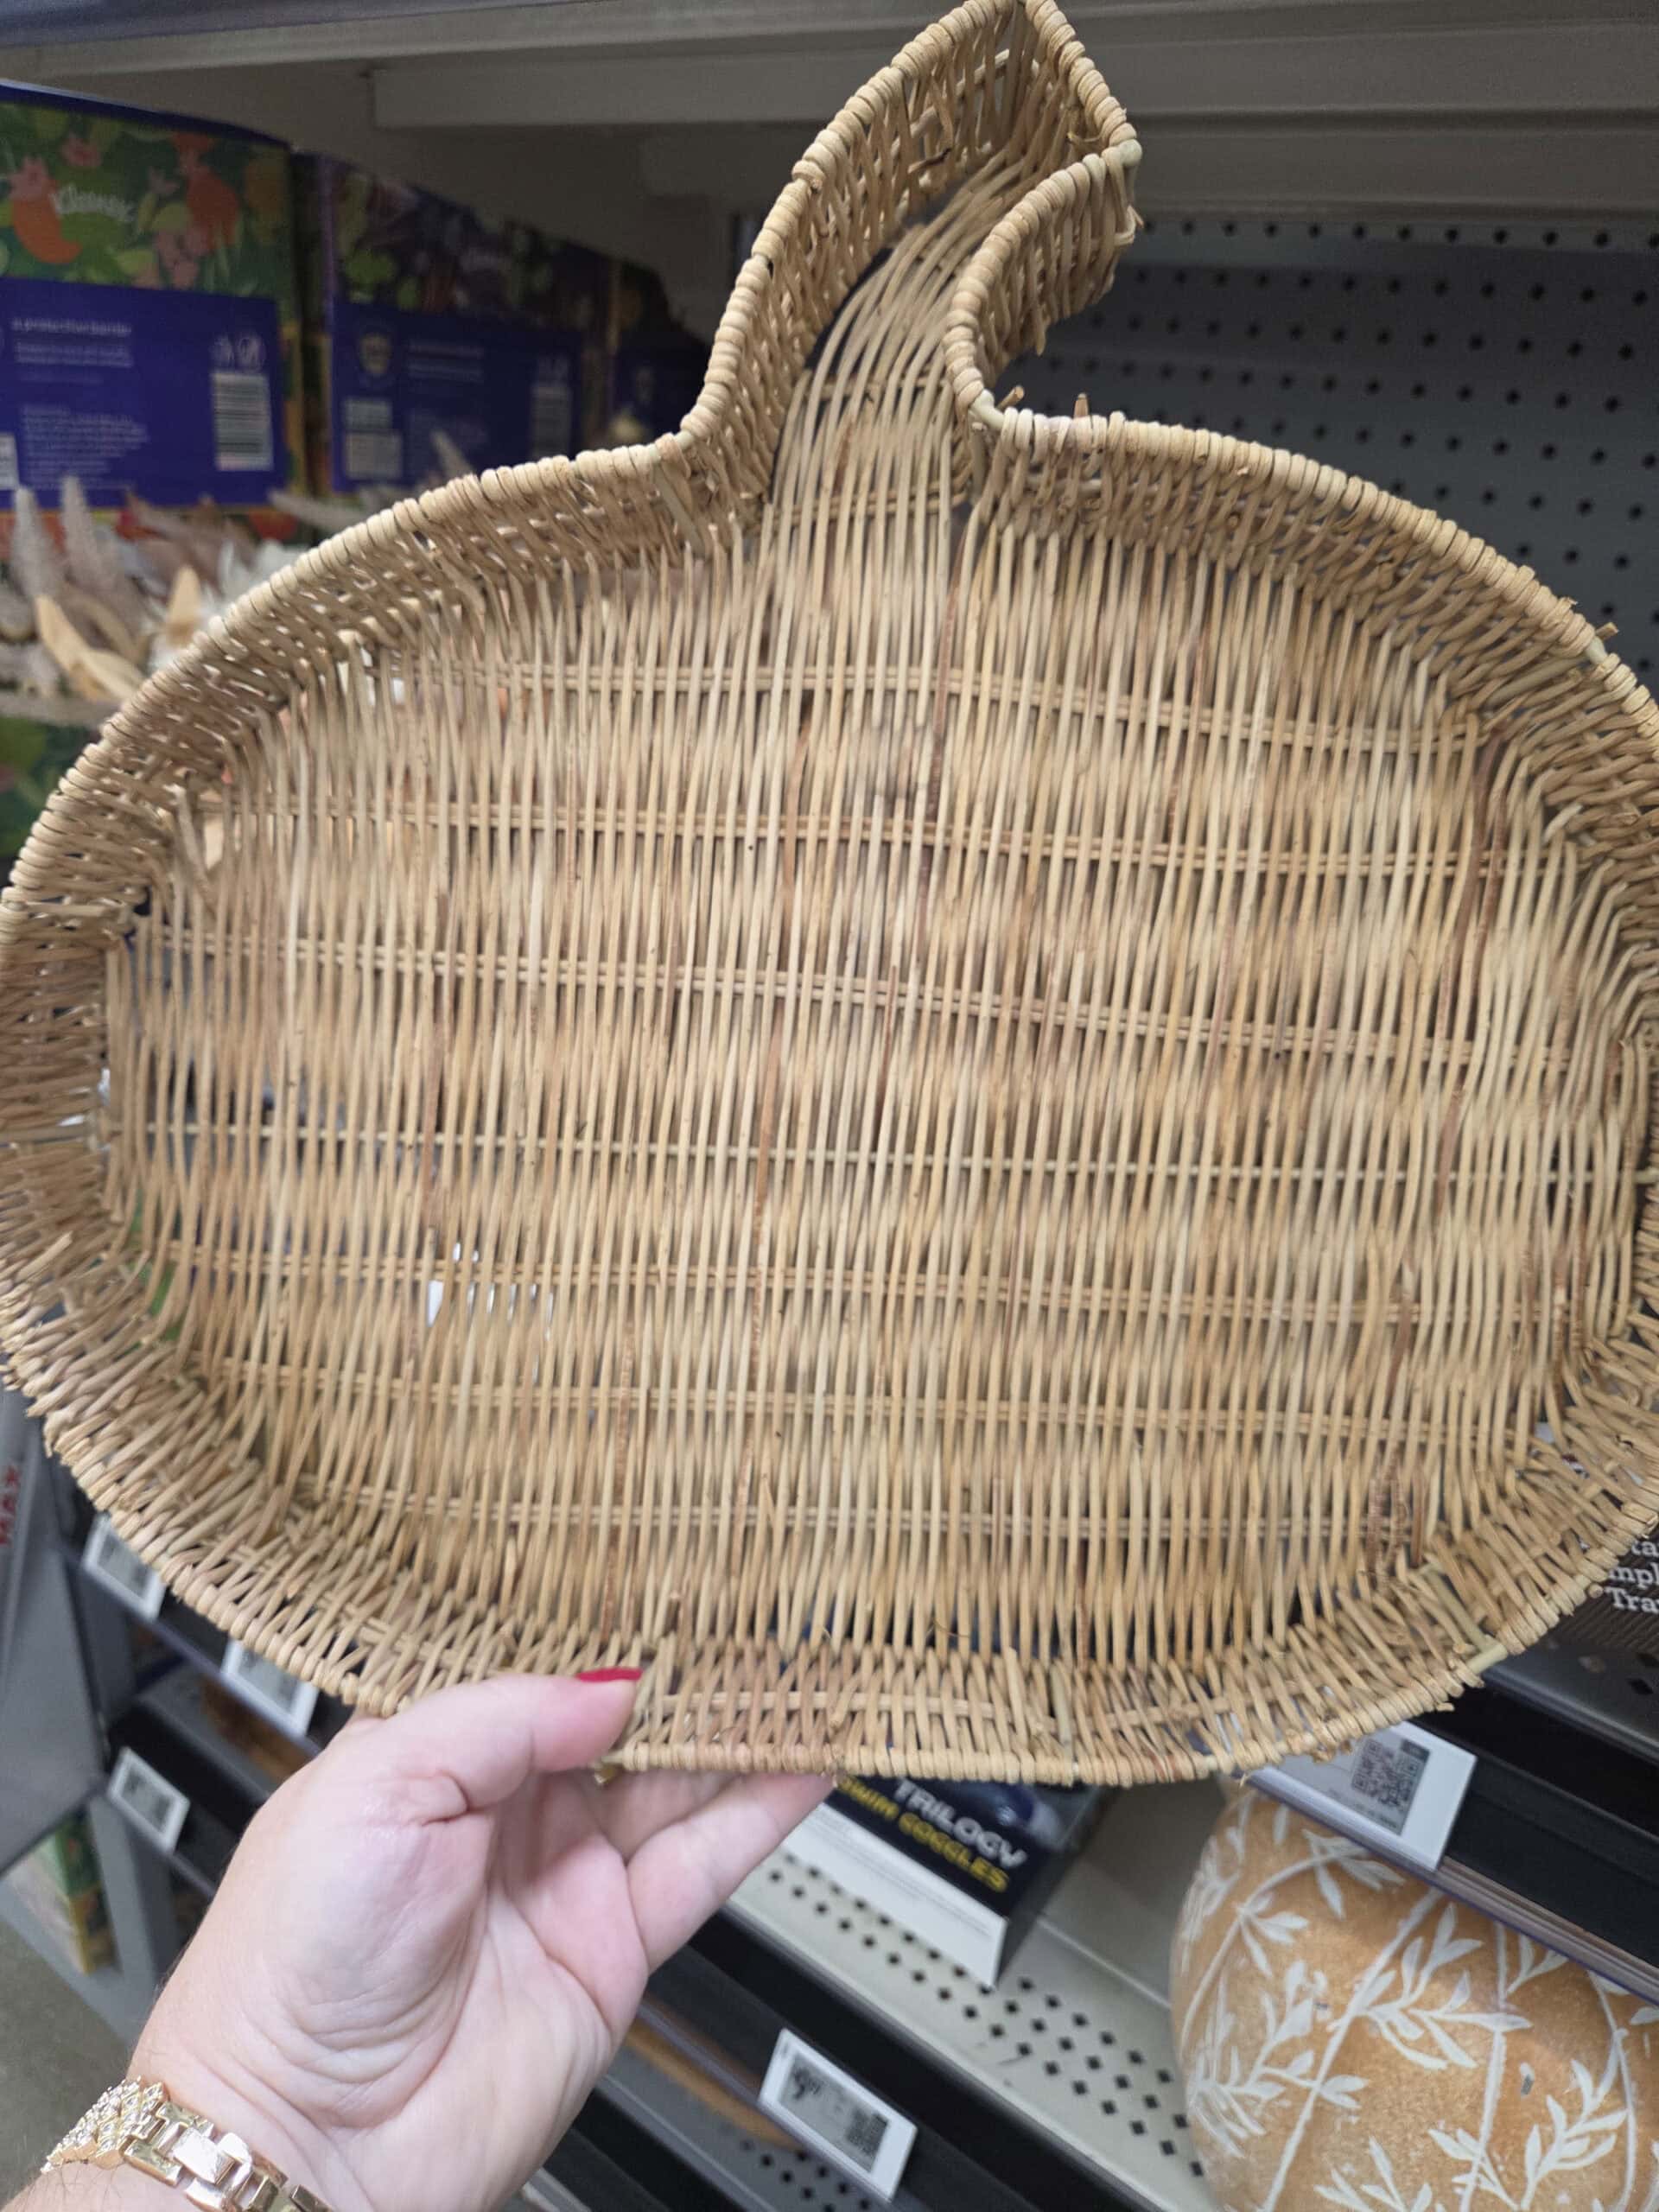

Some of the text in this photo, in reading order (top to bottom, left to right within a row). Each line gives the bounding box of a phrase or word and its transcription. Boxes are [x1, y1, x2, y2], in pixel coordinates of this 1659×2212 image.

[1604, 1586, 1659, 1614] Tra
[893, 1777, 1028, 1869] TRILOGY
[899, 1812, 1011, 1893] GOGGLES
